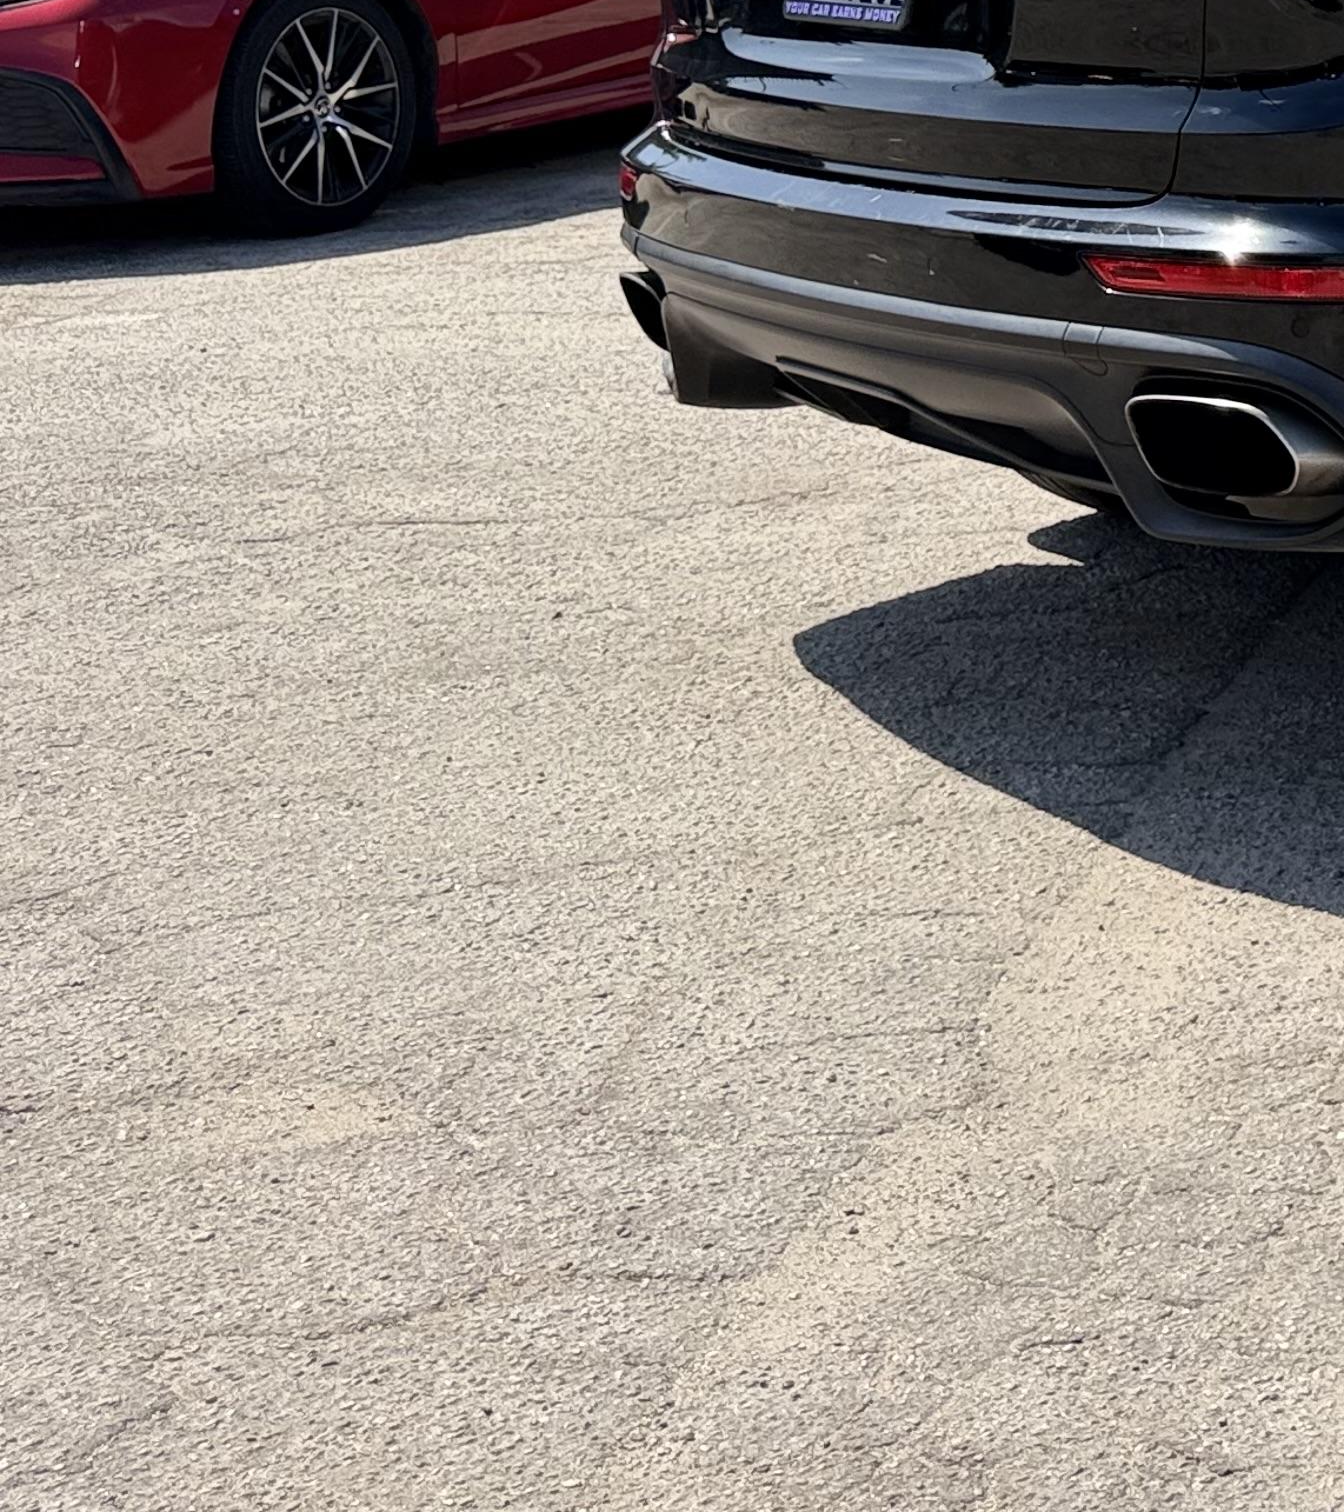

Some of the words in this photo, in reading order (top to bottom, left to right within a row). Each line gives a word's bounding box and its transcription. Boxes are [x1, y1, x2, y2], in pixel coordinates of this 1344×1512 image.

[786, 1, 810, 15] YOUR
[811, 3, 830, 16] CAR
[831, 4, 862, 19] EARNS
[864, 8, 900, 23] MONEY
